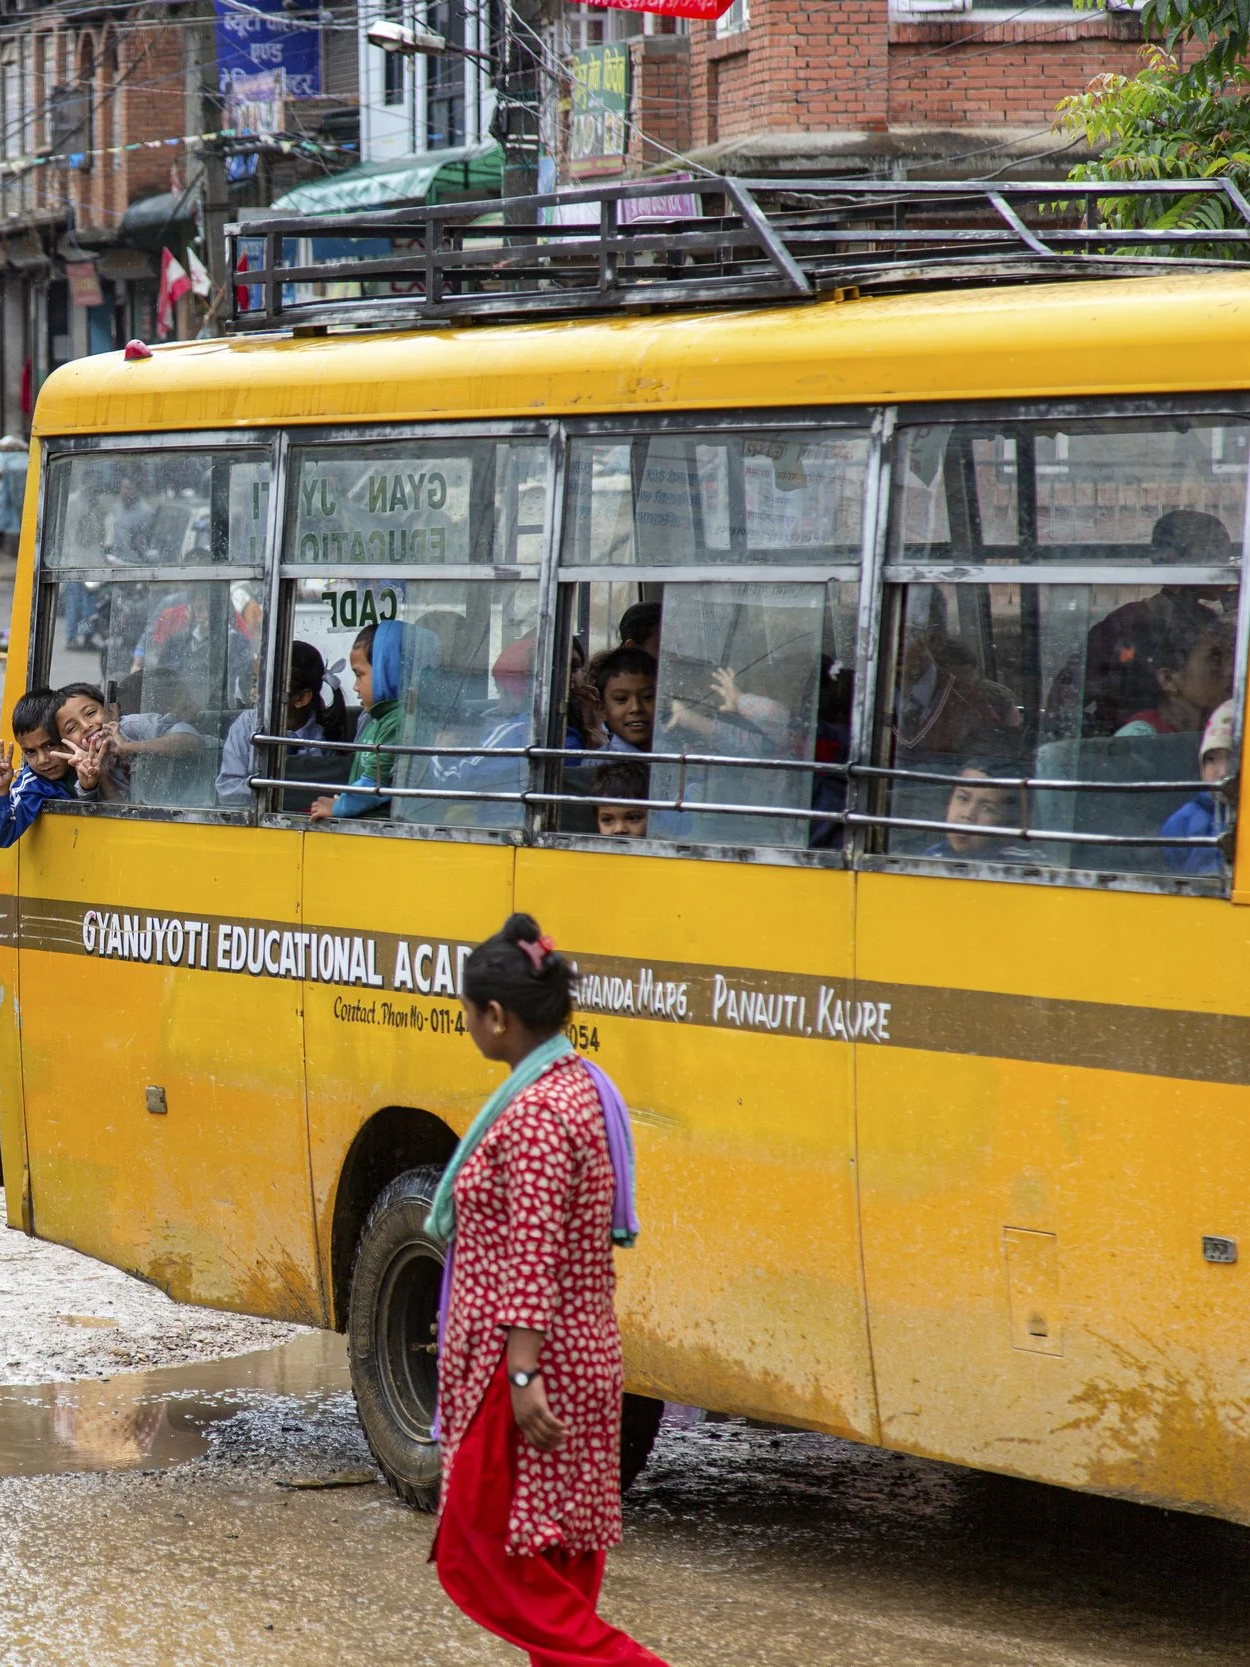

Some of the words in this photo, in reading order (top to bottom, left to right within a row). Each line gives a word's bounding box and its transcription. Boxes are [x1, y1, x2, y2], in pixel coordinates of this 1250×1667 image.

[82, 910, 210, 969] GYANJYOTI
[217, 924, 385, 988] EDUCATIONAL
[394, 941, 473, 999] ACAD
